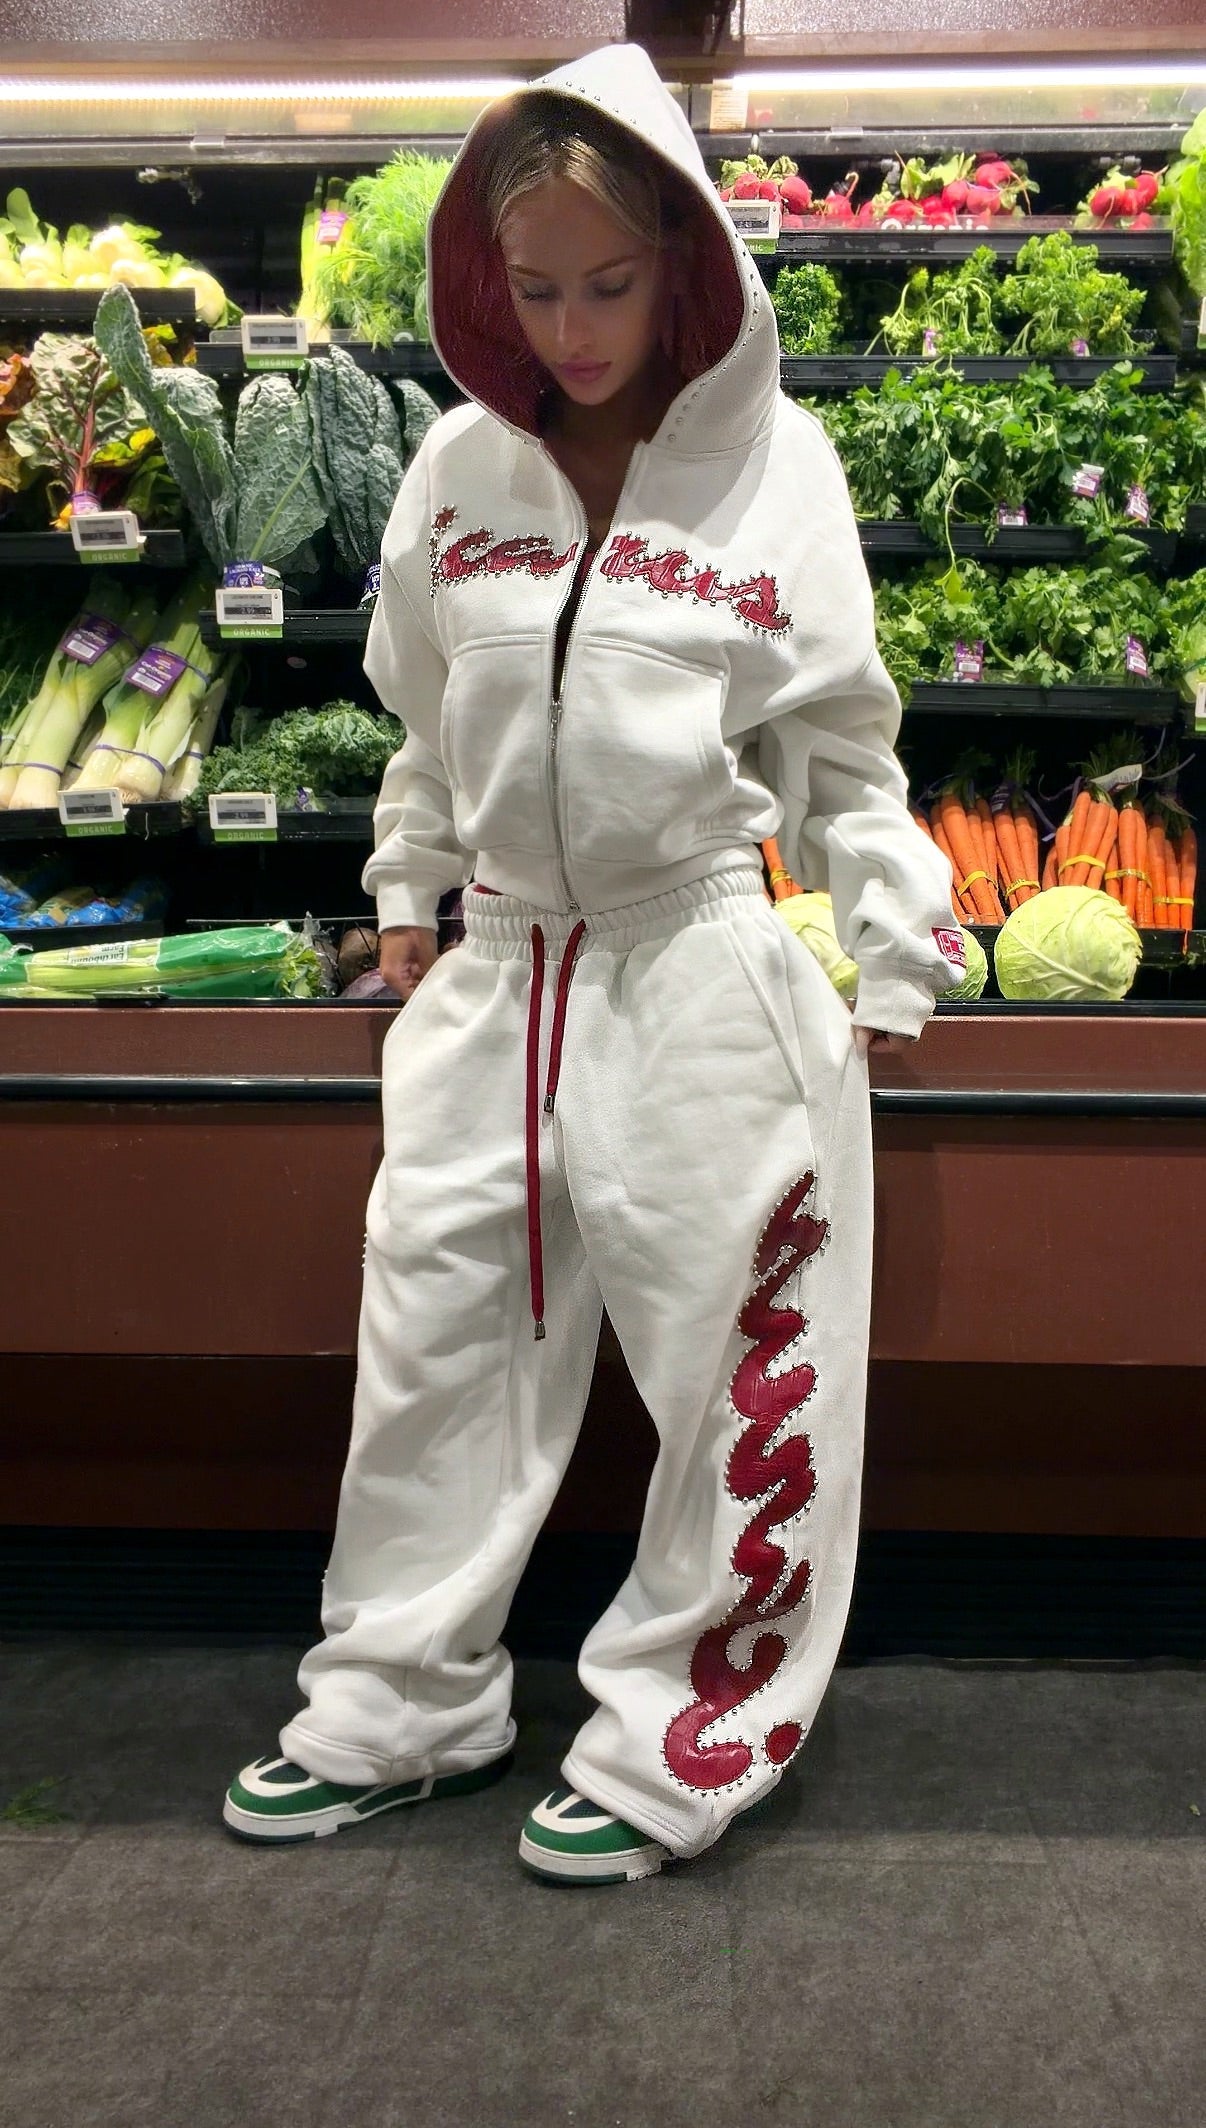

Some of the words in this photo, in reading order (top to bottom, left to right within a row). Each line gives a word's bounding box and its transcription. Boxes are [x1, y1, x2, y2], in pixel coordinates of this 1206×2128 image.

[258, 359, 296, 367] ORGANIC
[91, 552, 128, 561] ORGANIC
[232, 628, 271, 637] ORGANIC
[78, 825, 113, 834] ORGANIC
[226, 831, 265, 840] ORGANIC
